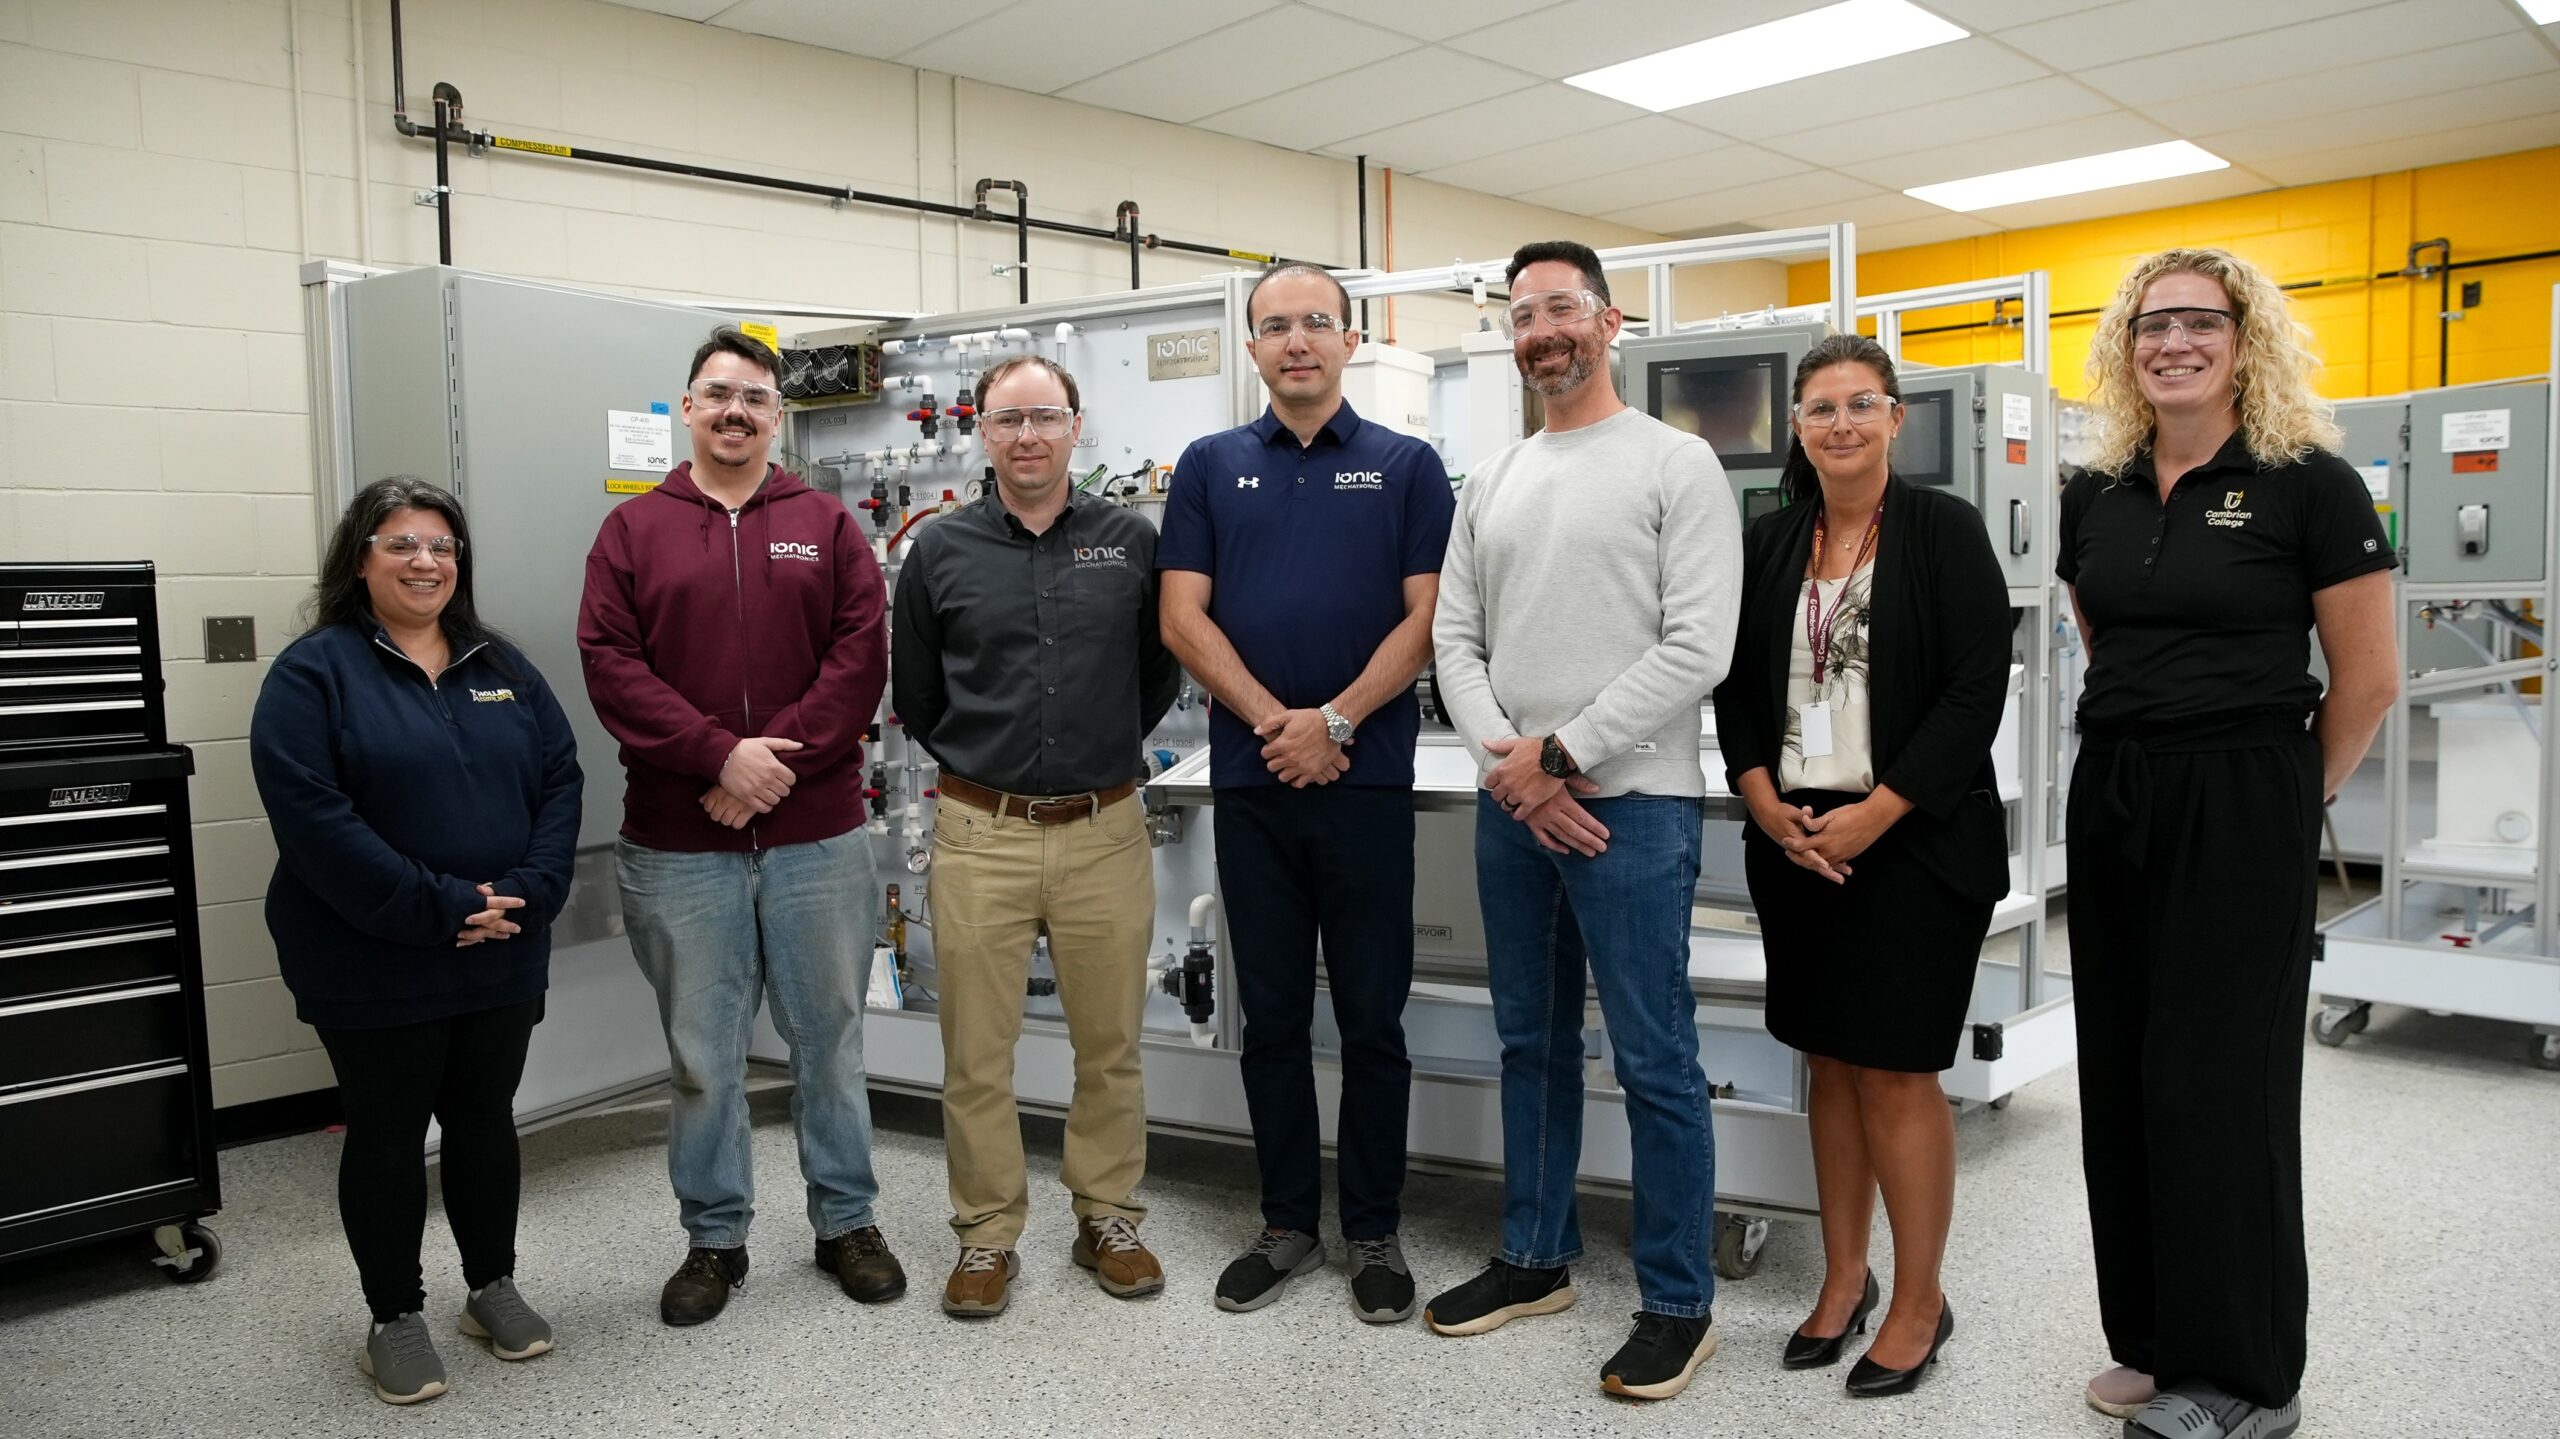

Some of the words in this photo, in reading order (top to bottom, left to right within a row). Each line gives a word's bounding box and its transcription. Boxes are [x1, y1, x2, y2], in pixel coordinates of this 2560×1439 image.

[500, 137, 553, 153] COMPRESSED
[554, 145, 567, 154] AIR
[1156, 336, 1209, 357] IONIC
[1156, 355, 1209, 367] MECHATRONICS
[647, 456, 668, 465] IONIC
[1334, 471, 1383, 484] IONIC
[2205, 510, 2252, 519] Cambrian
[2207, 518, 2245, 528] College
[770, 542, 819, 556] IONIC
[1073, 546, 1126, 561] IONIC
[770, 553, 820, 562] MECHATRONICS
[1074, 560, 1128, 569] MECHATRONICS
[24, 593, 103, 607] WATERLOO
[1809, 606, 1817, 640] Cambrian
[1817, 620, 1830, 655] Cambrian
[51, 785, 130, 804] WATERLOO
